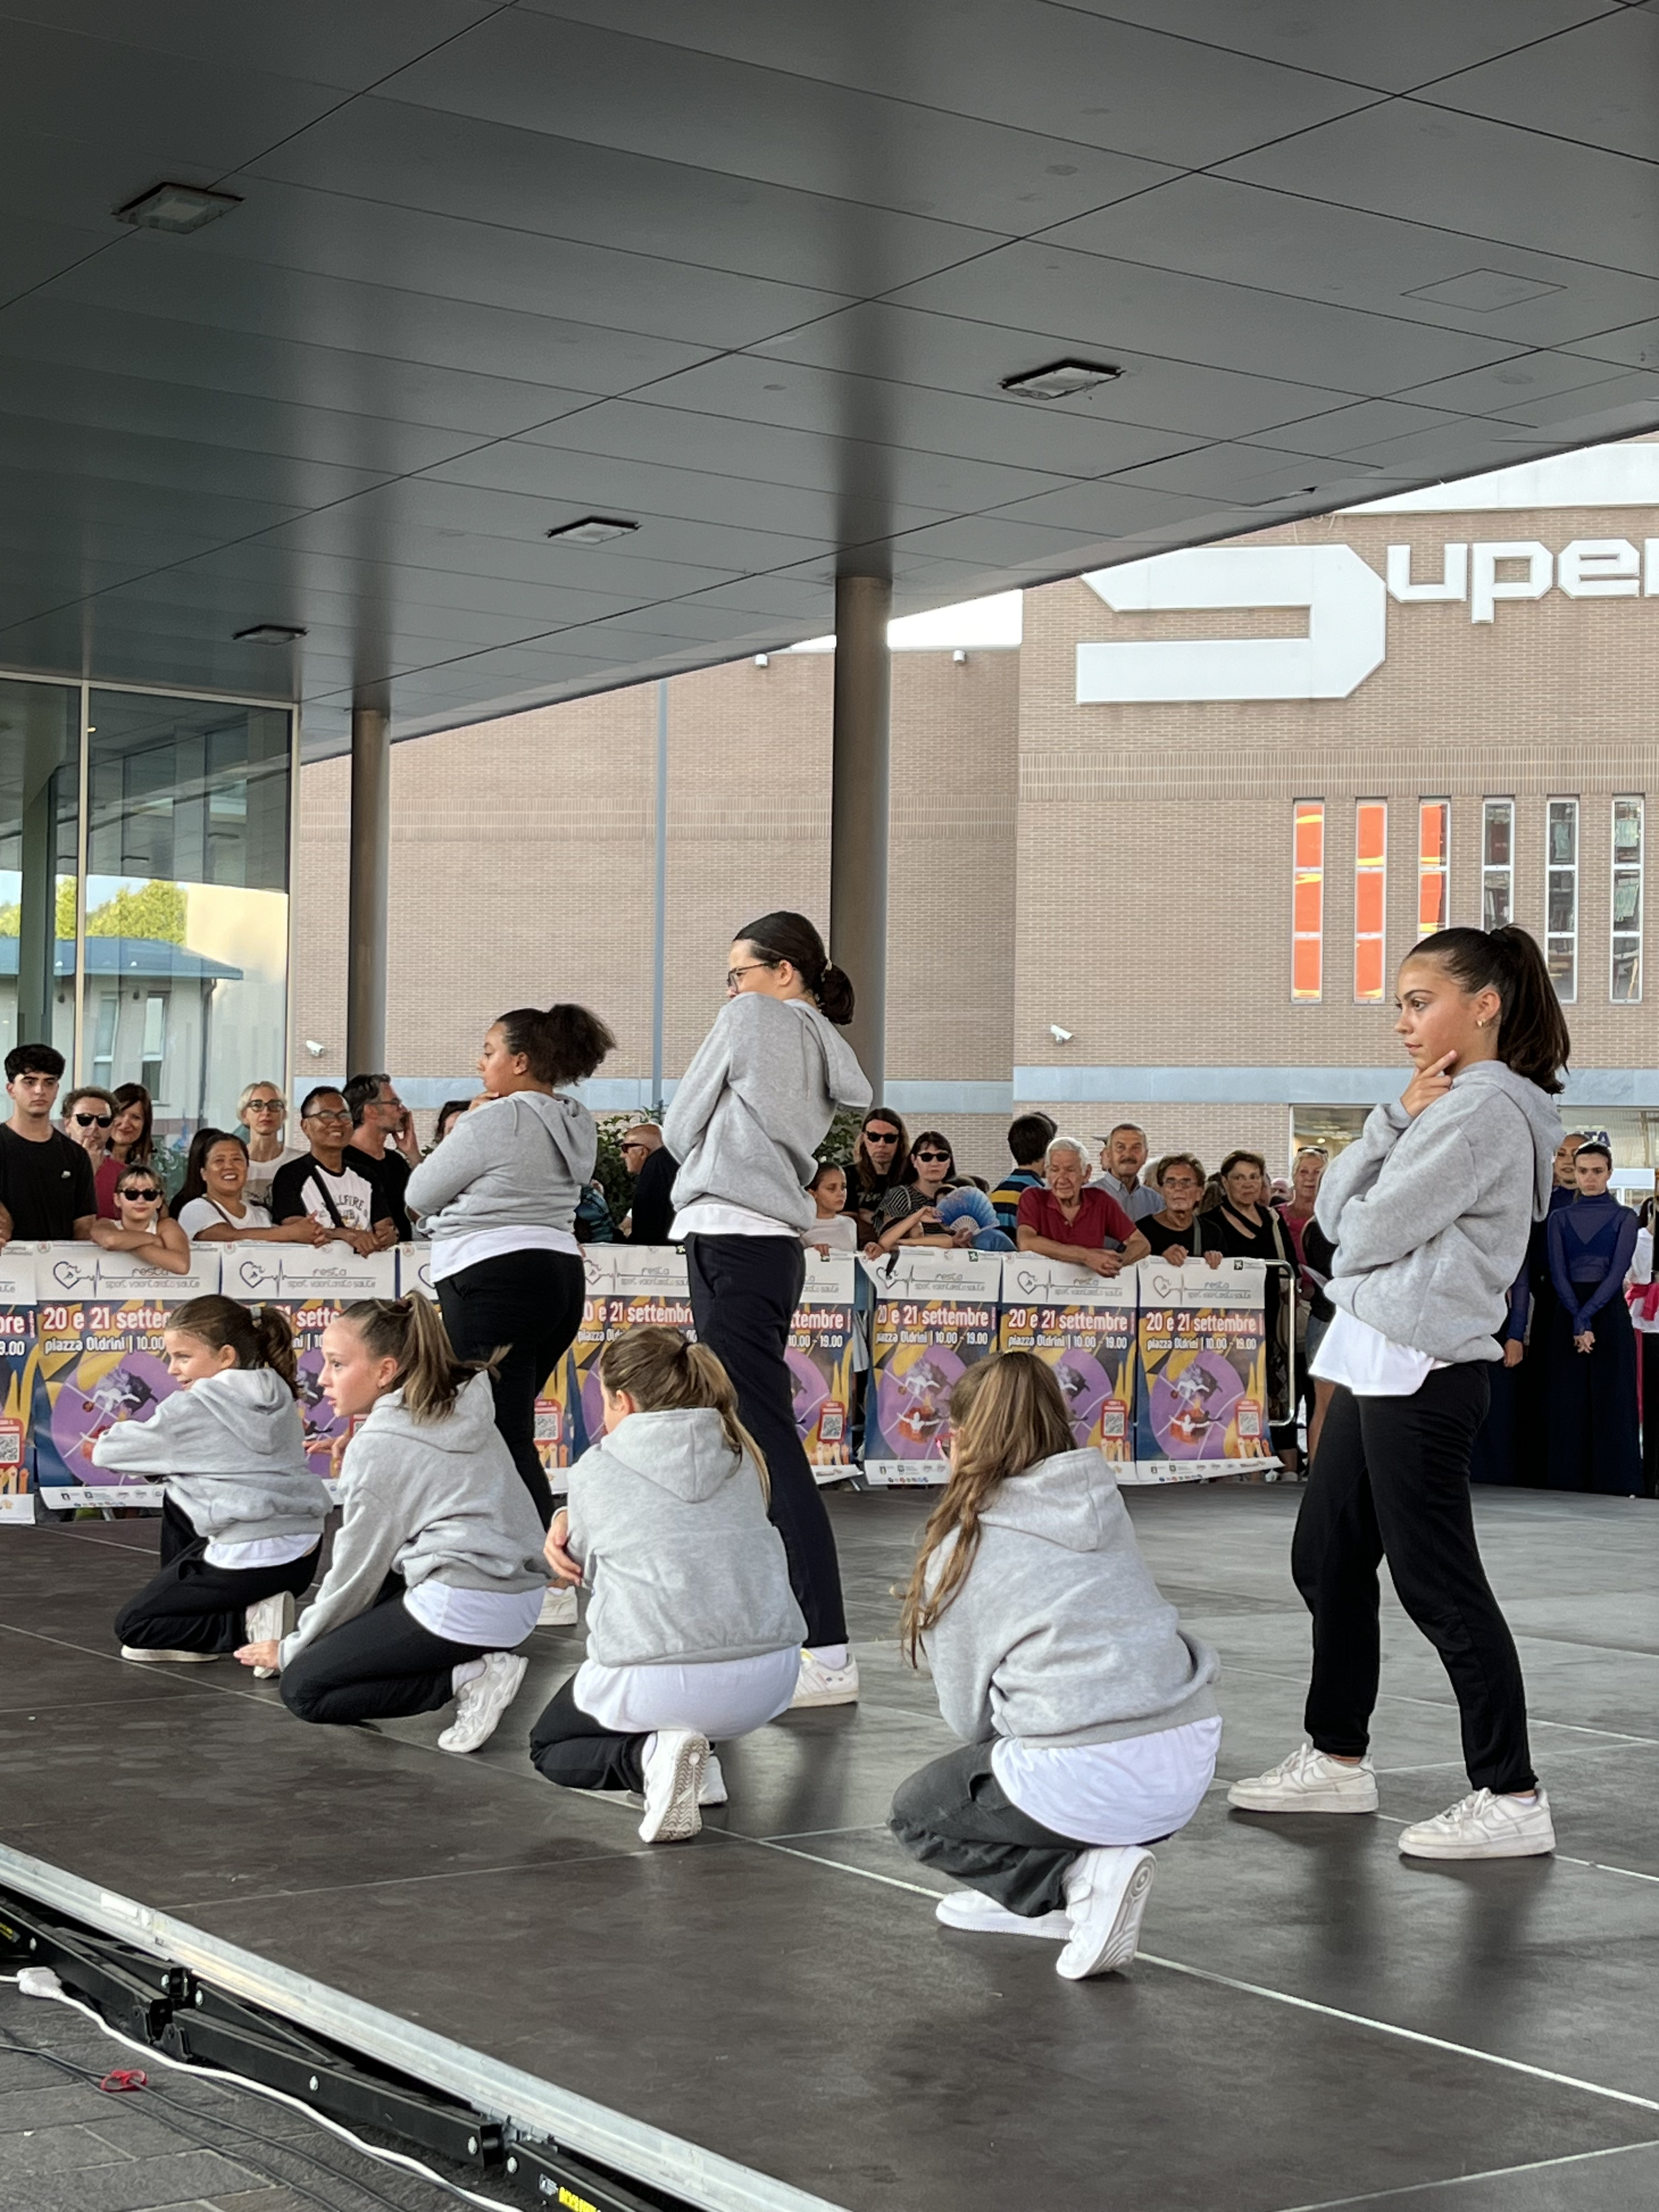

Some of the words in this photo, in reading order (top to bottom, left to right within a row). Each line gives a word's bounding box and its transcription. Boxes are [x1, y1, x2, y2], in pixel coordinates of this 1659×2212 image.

[1076, 538, 1659, 705] Supe
[43, 1307, 67, 1329] 20
[73, 1312, 84, 1329] e
[91, 1307, 109, 1329] 21
[584, 1301, 594, 1322] 0
[599, 1306, 606, 1322] e
[610, 1302, 624, 1322] 21
[627, 1303, 693, 1323] settembr
[891, 1309, 900, 1324] e
[903, 1305, 917, 1324] 21
[922, 1307, 989, 1327] settembre
[1008, 1309, 1026, 1328] 20
[1030, 1314, 1039, 1328] e
[1041, 1310, 1056, 1328] 21
[1059, 1312, 1127, 1331] settembre
[1146, 1312, 1163, 1331] 20
[1167, 1317, 1174, 1331] e
[1177, 1313, 1190, 1331] 21
[1194, 1313, 1256, 1332] settembre
[45, 1338, 83, 1355] piazza
[87, 1336, 125, 1351] Oldrini
[137, 1336, 165, 1351] 10.00
[788, 1334, 811, 1347] 10.00
[820, 1335, 843, 1347] 19.00
[900, 1331, 928, 1343] Oldrini
[935, 1331, 957, 1344] 10.00
[967, 1332, 988, 1345] 19.00
[1037, 1334, 1065, 1347] Oldrini
[1074, 1335, 1096, 1348] 10.00
[1105, 1336, 1127, 1349] 19.00
[1147, 1339, 1172, 1350] piazza
[1206, 1338, 1227, 1350] 10.00
[1236, 1338, 1257, 1350] 19.00
